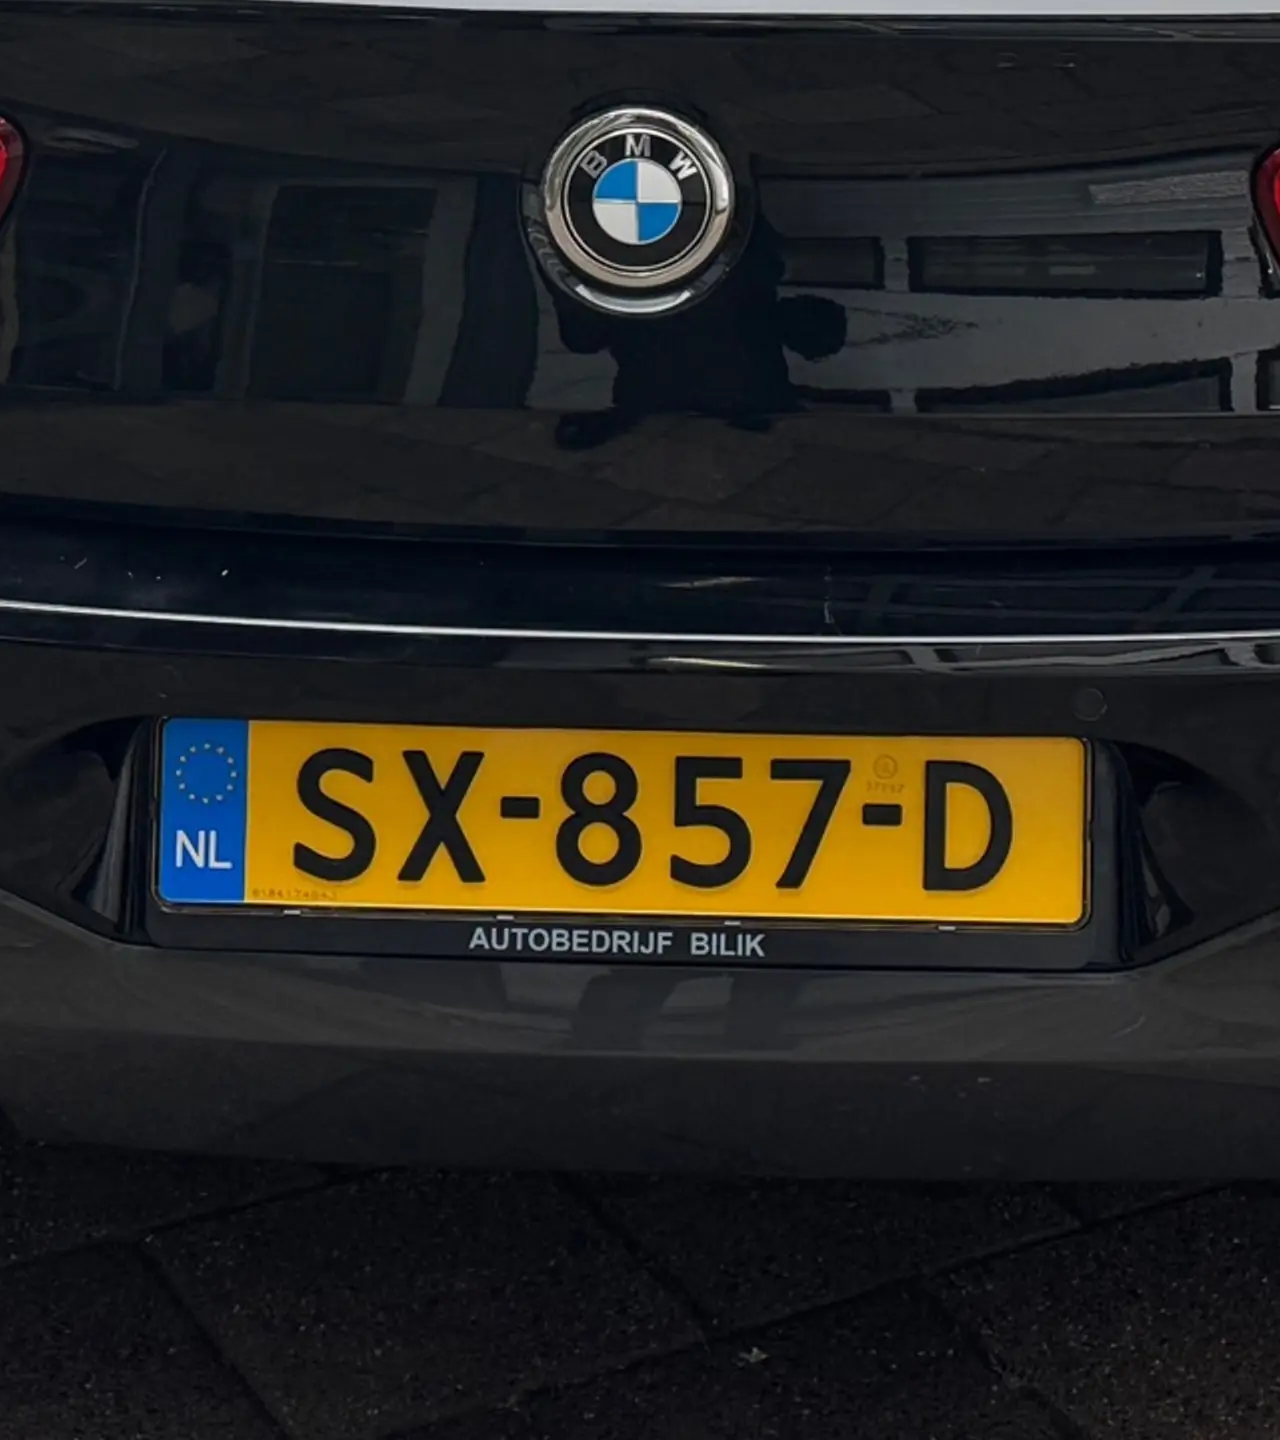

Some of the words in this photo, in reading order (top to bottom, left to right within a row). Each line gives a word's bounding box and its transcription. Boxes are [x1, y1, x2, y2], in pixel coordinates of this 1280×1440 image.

[579, 133, 698, 179] BMW
[292, 747, 1014, 893] SX-857-D
[175, 829, 234, 870] NL
[469, 927, 673, 954] AUTOBEDRIJF
[689, 932, 766, 957] BILIK
